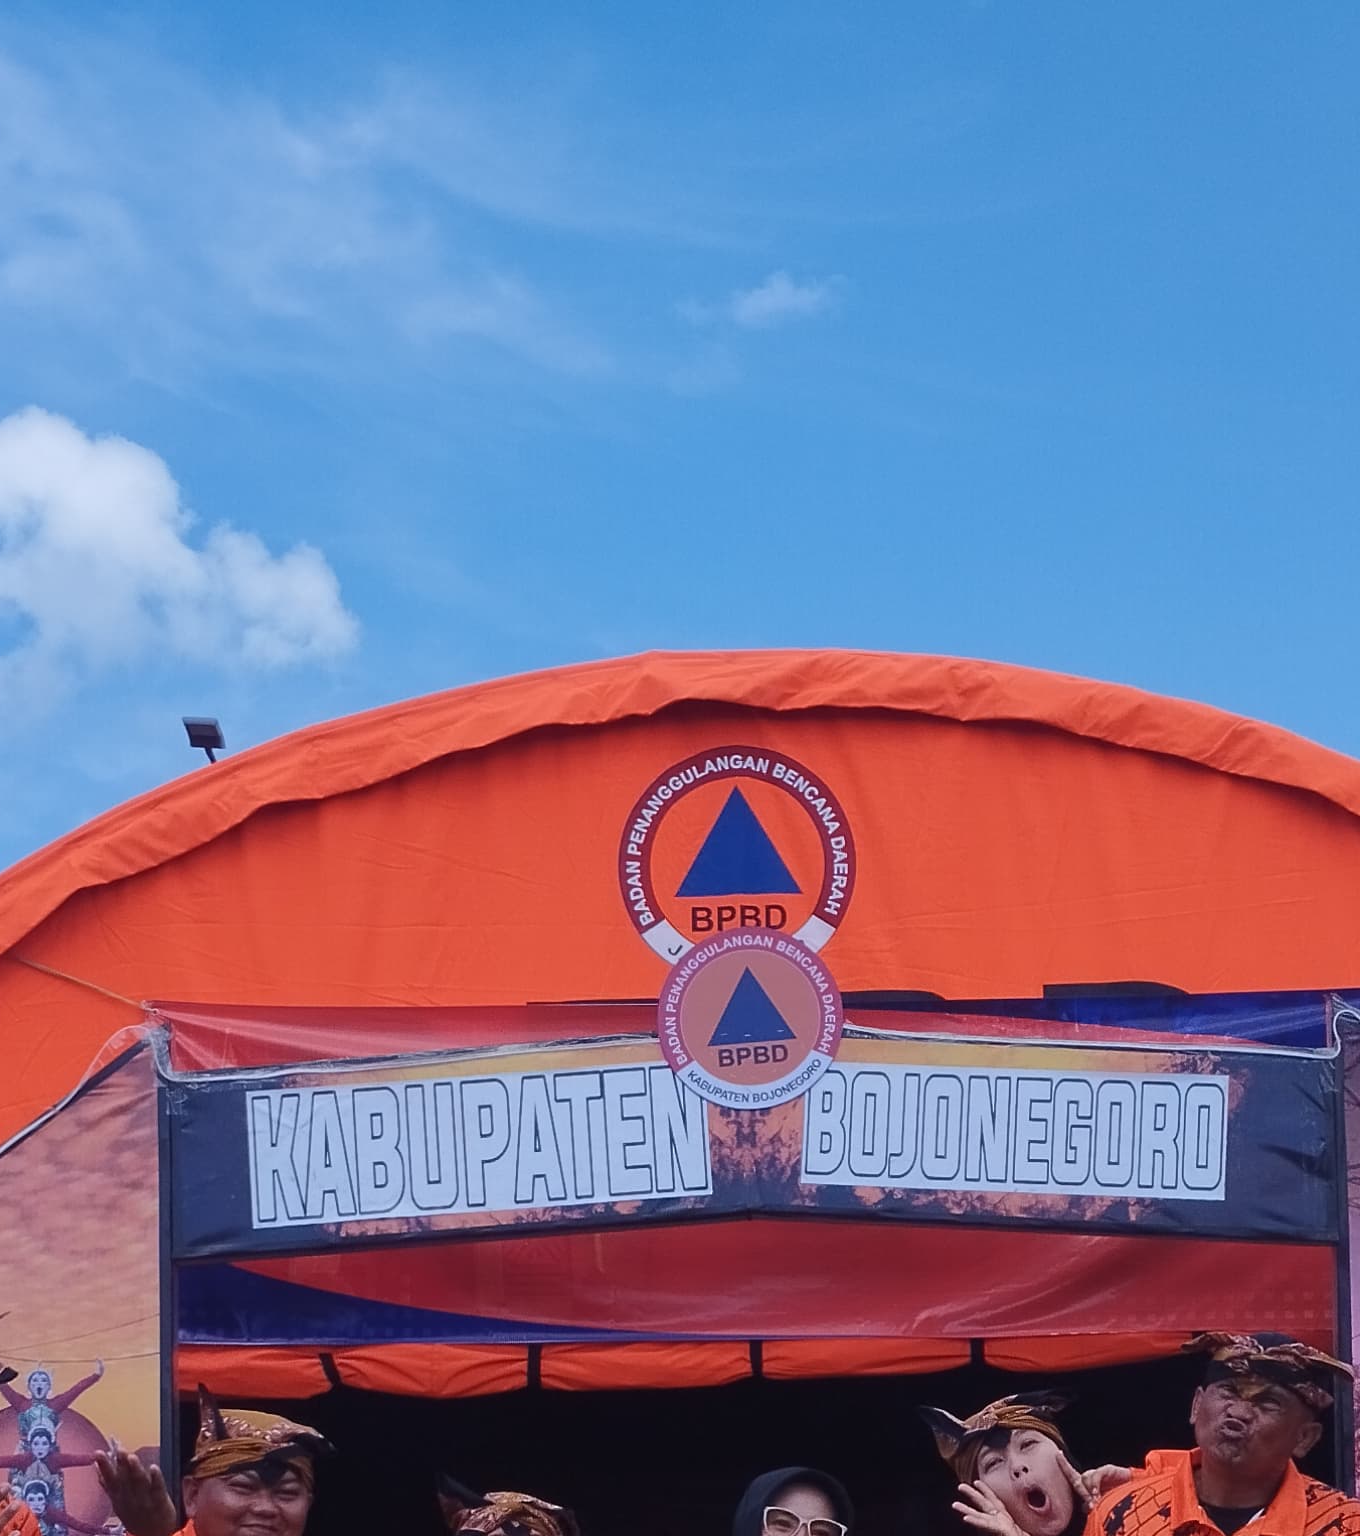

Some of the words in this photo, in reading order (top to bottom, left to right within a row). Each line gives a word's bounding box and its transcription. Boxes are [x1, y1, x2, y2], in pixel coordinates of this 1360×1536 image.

[627, 755, 769, 856] PENANGGULANGAN
[772, 763, 840, 834] BENCANA
[626, 861, 655, 926] BADAN
[824, 836, 848, 915] DAERAH
[691, 904, 787, 932] BPBD
[666, 934, 773, 1013] PENANGGULANGAN
[776, 940, 829, 992] BENCANA
[665, 1017, 688, 1065] BADAN
[818, 994, 835, 1053] DAERAH
[687, 1070, 749, 1103] KABUPATEN
[752, 1058, 822, 1103] BOJONEGORO
[718, 1044, 788, 1067] BPBD
[252, 1066, 709, 1223] KABUPATEN
[805, 1070, 1225, 1191] BOJONEGORO
